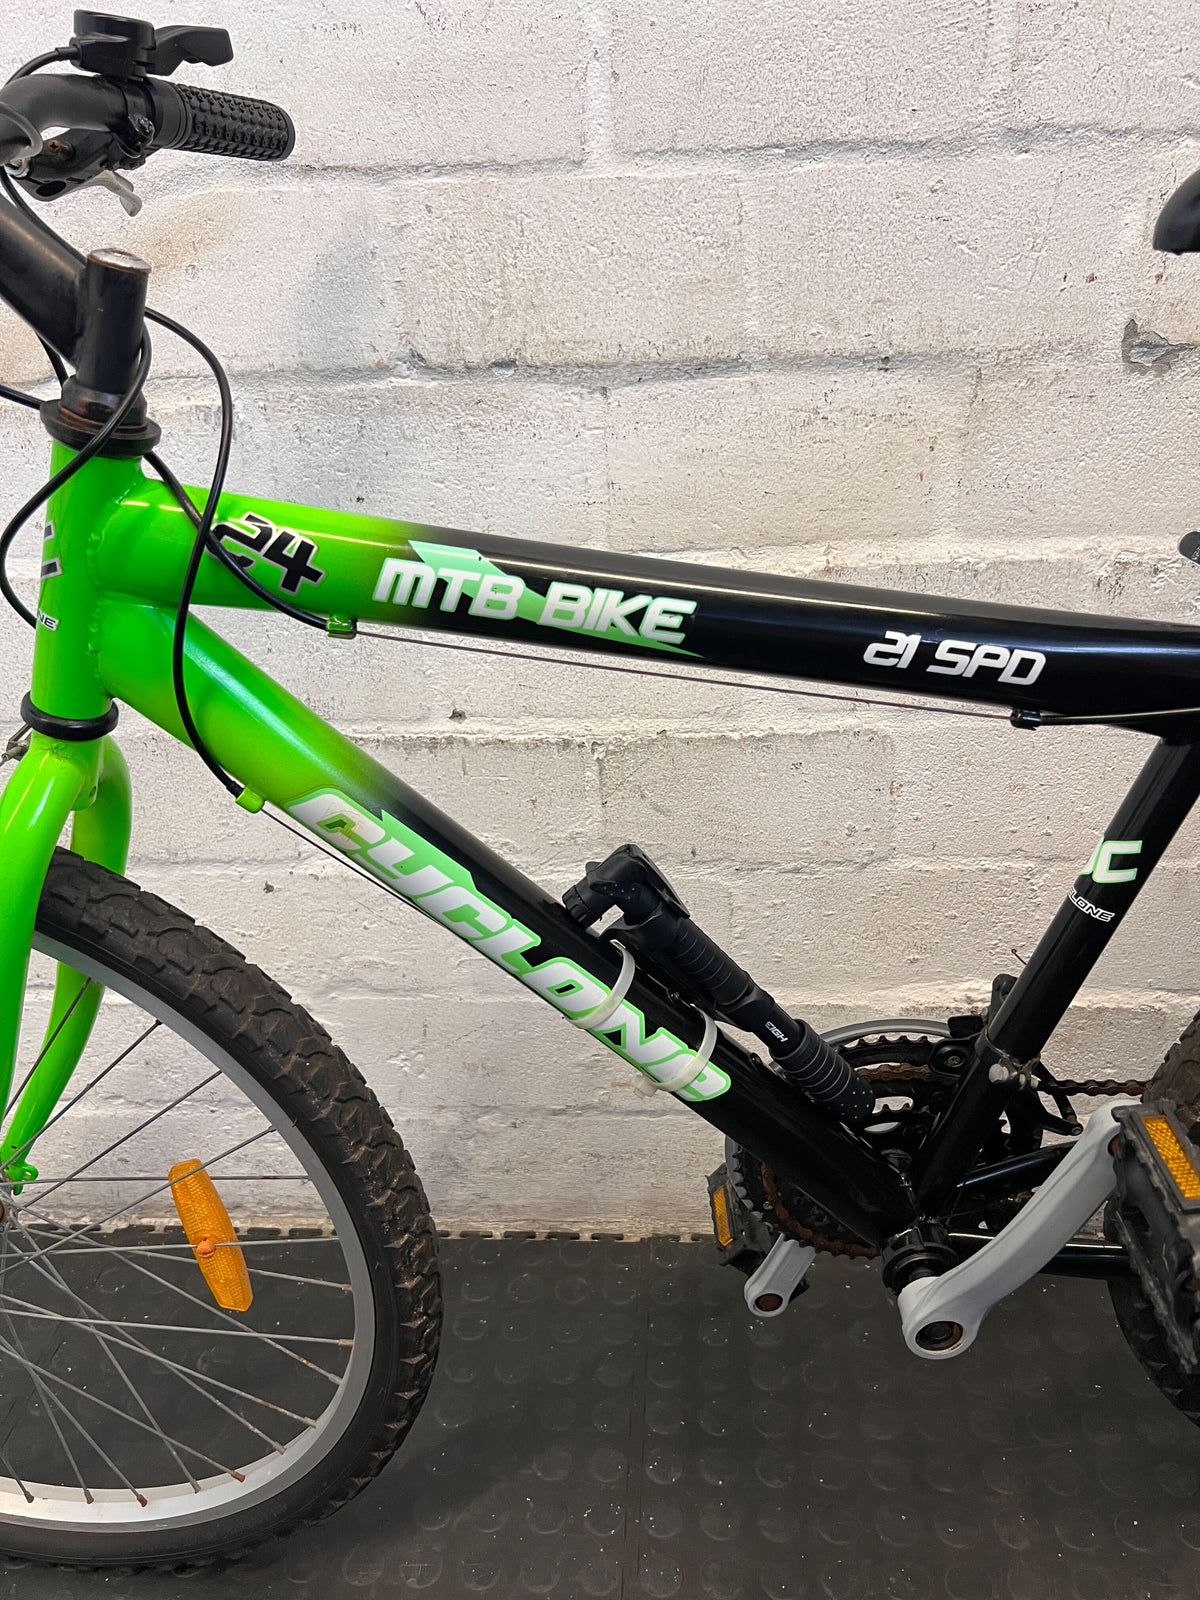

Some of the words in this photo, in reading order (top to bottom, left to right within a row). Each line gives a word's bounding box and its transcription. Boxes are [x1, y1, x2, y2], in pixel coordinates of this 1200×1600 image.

[205, 511, 325, 595] 24
[373, 557, 525, 620] MTB
[538, 581, 697, 644] BIKE
[863, 630, 922, 669] 21
[926, 639, 1047, 686] SPD
